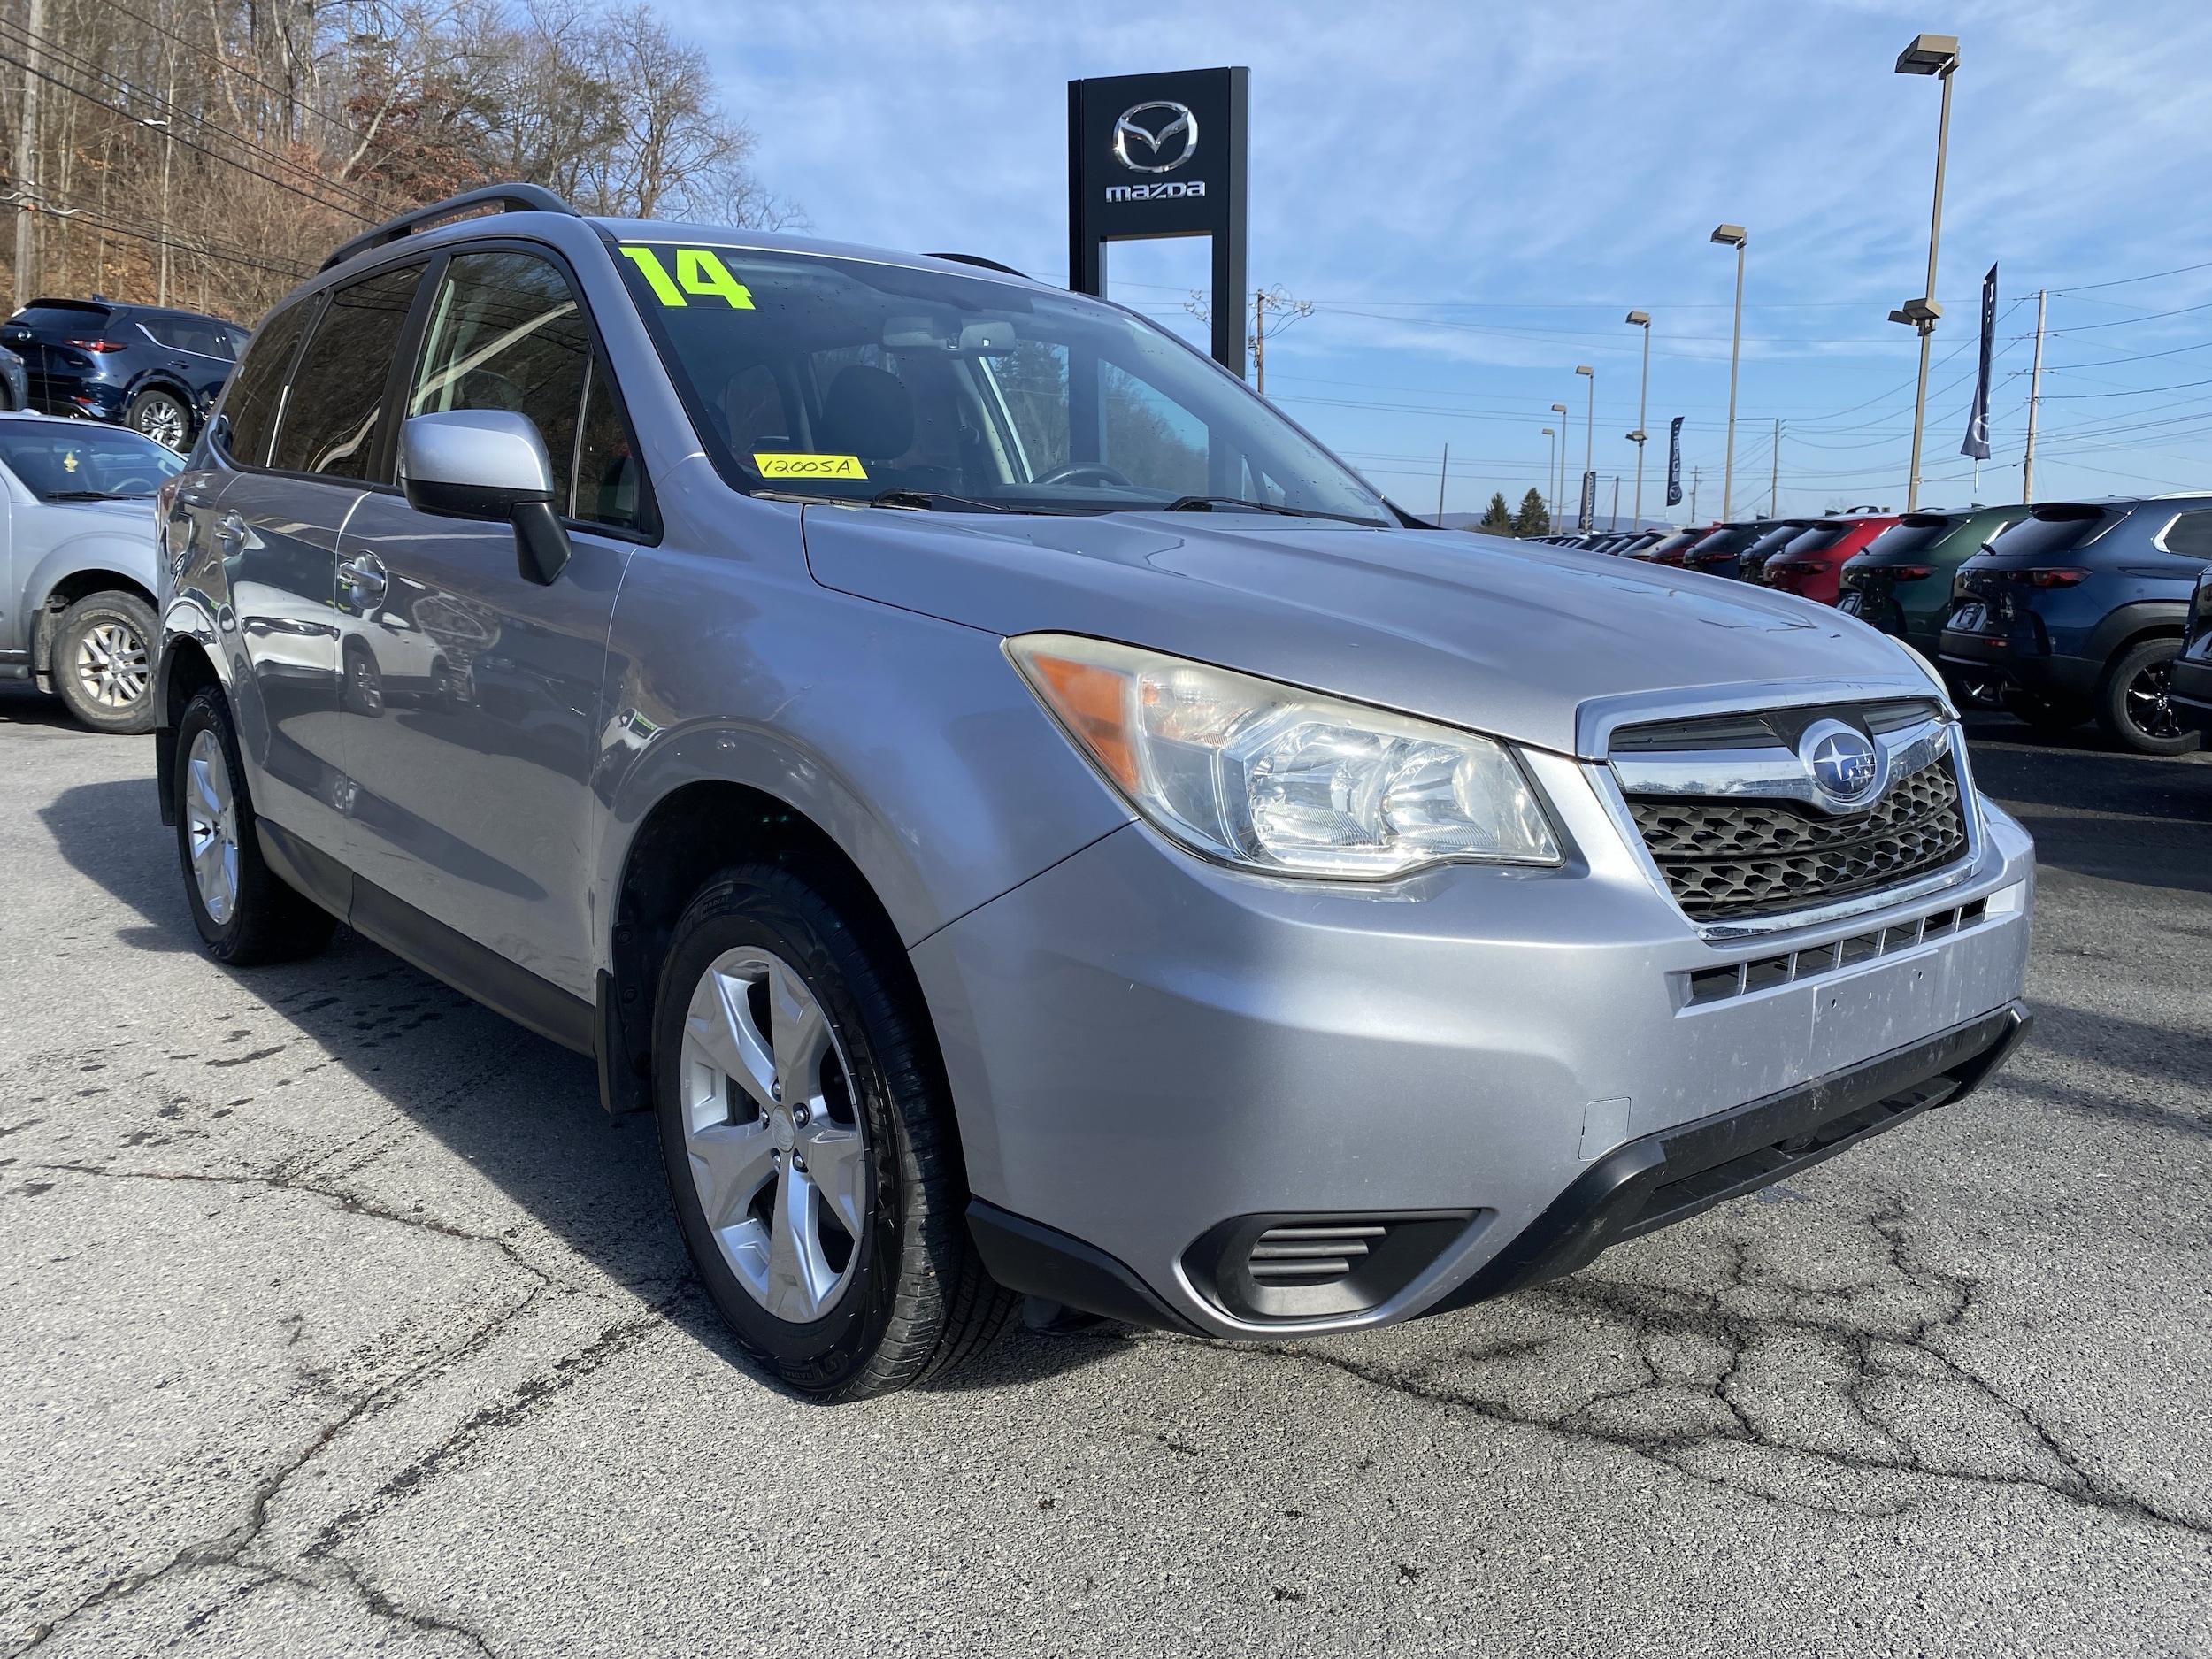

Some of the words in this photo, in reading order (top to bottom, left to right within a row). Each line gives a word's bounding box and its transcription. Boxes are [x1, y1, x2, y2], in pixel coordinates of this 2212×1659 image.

[1106, 180, 1206, 203] mazda
[618, 247, 757, 310] 14
[764, 459, 855, 474] 12005A
